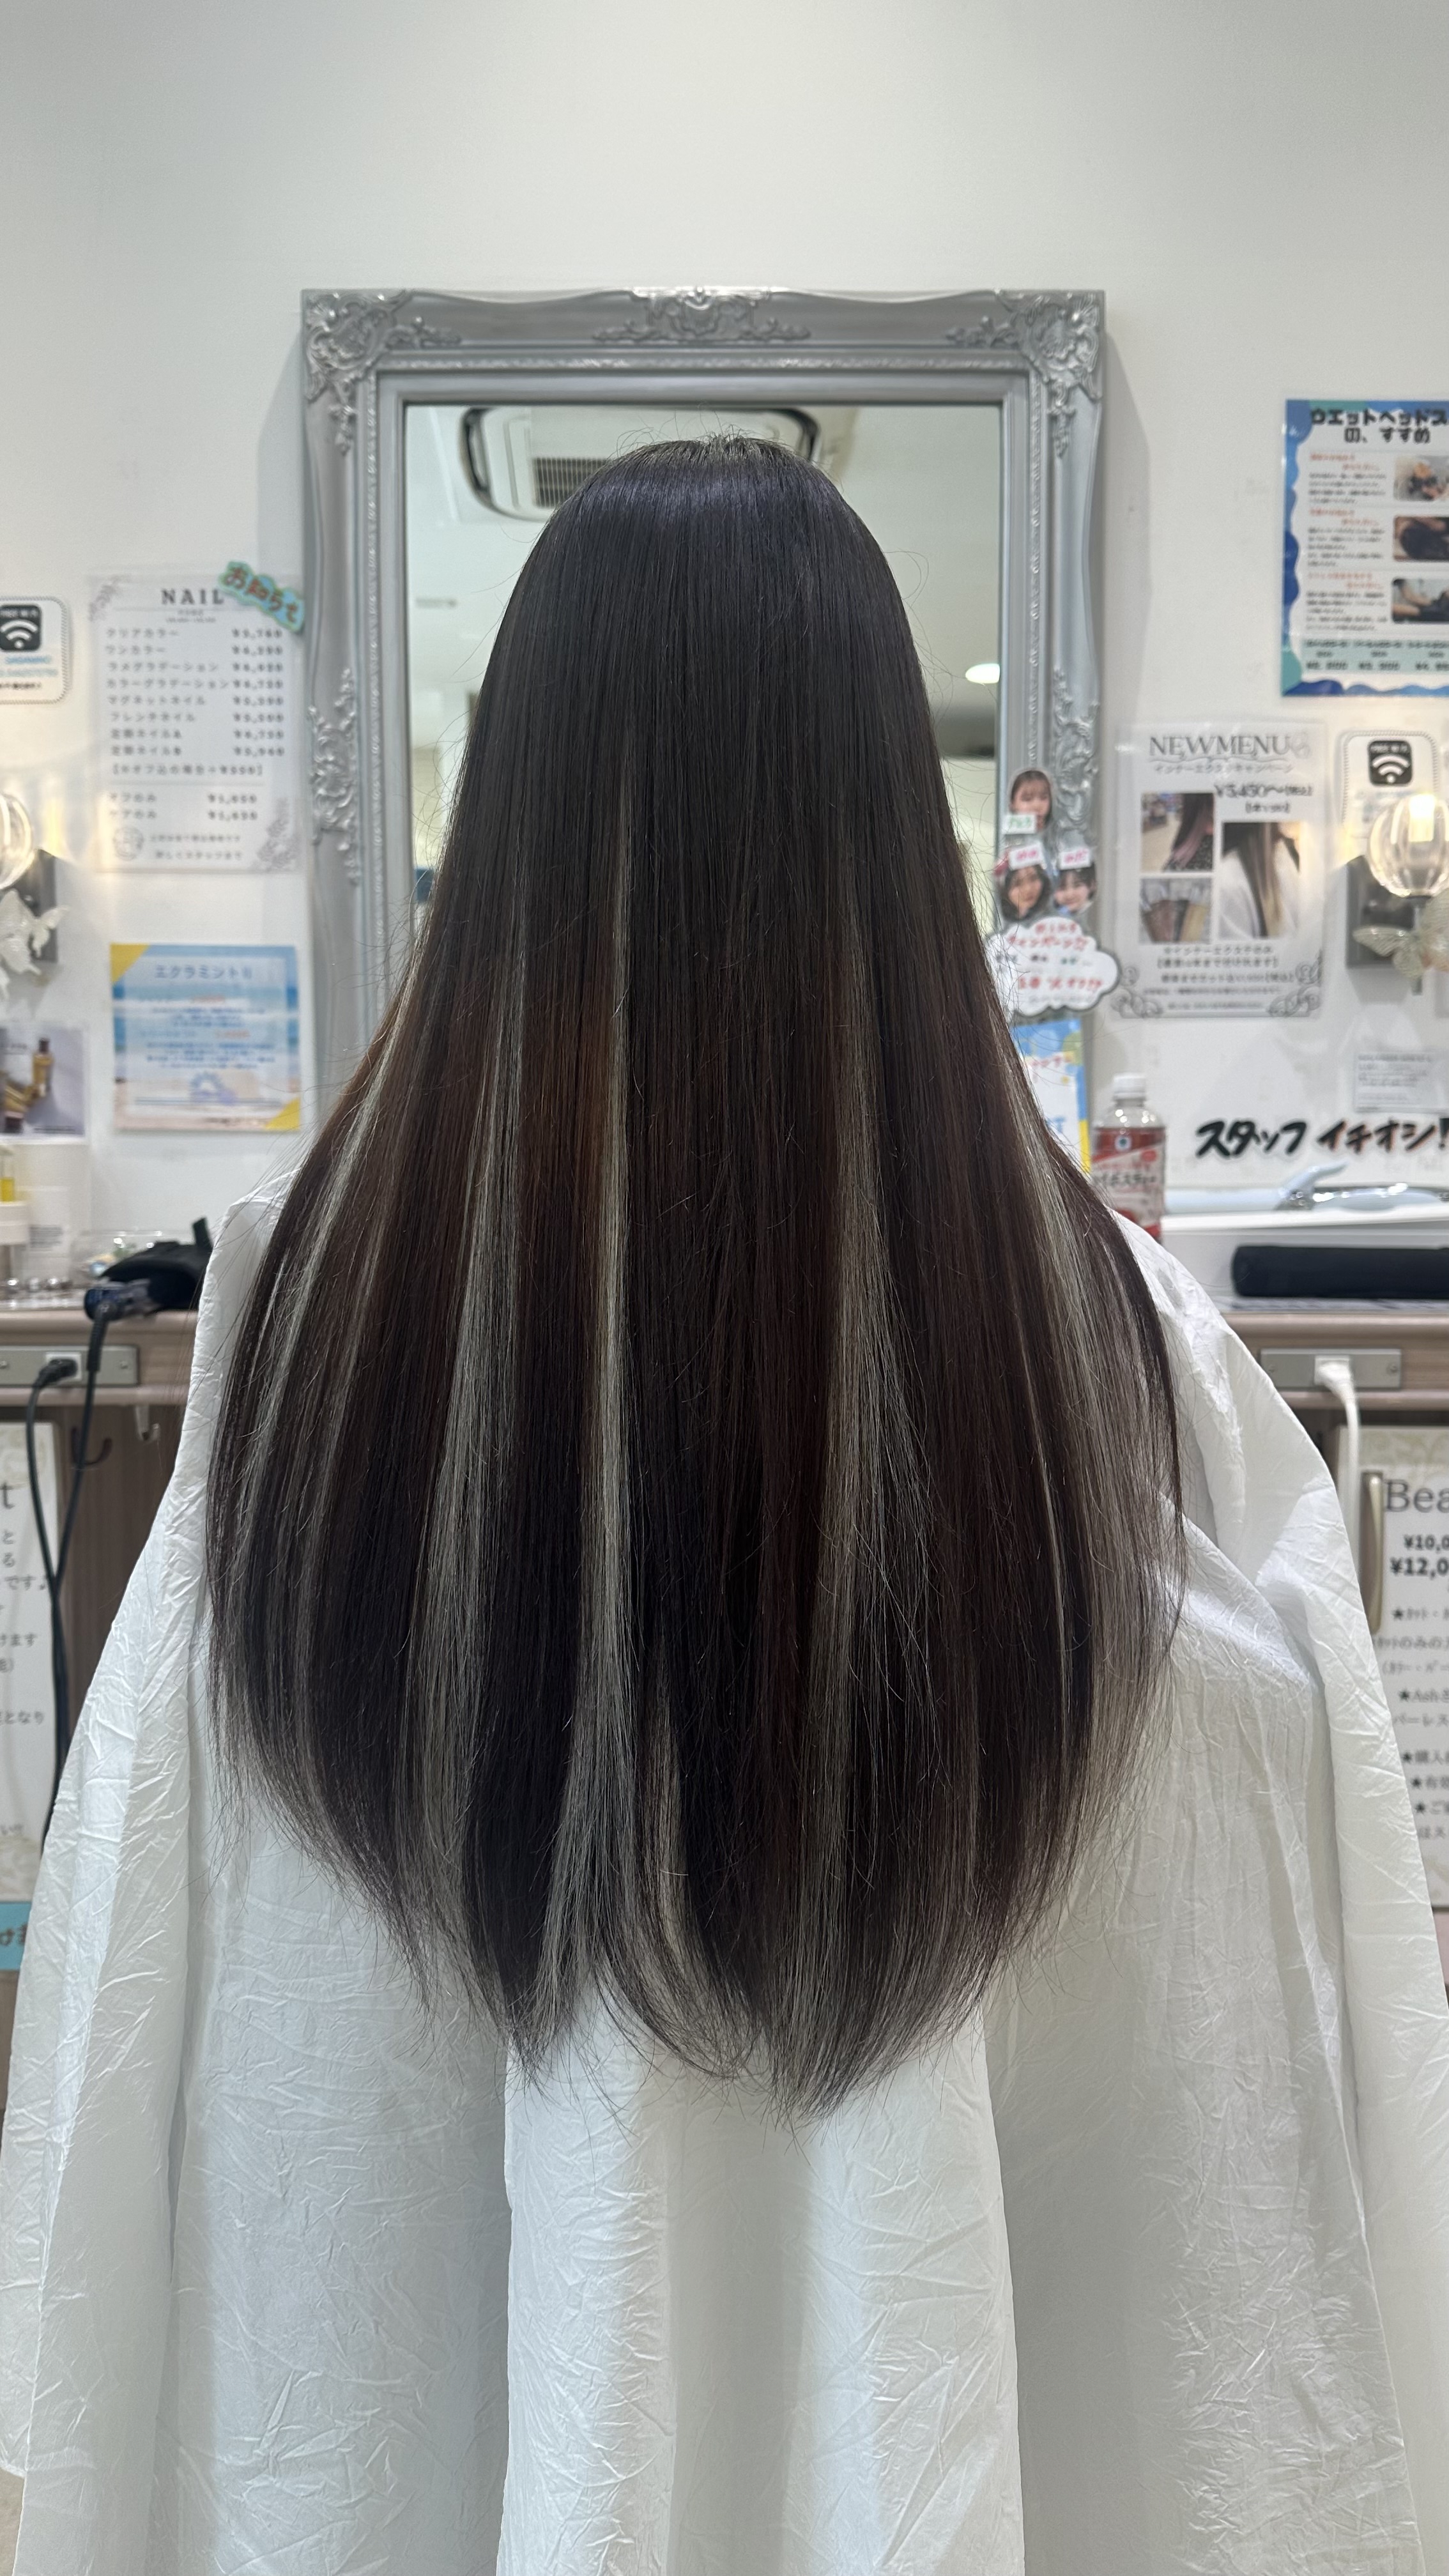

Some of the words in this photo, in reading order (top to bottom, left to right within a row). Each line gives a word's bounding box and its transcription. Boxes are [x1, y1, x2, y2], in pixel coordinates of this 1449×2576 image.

[161, 588, 224, 605] NAIL
[1196, 1120, 1307, 1158] スタッフ
